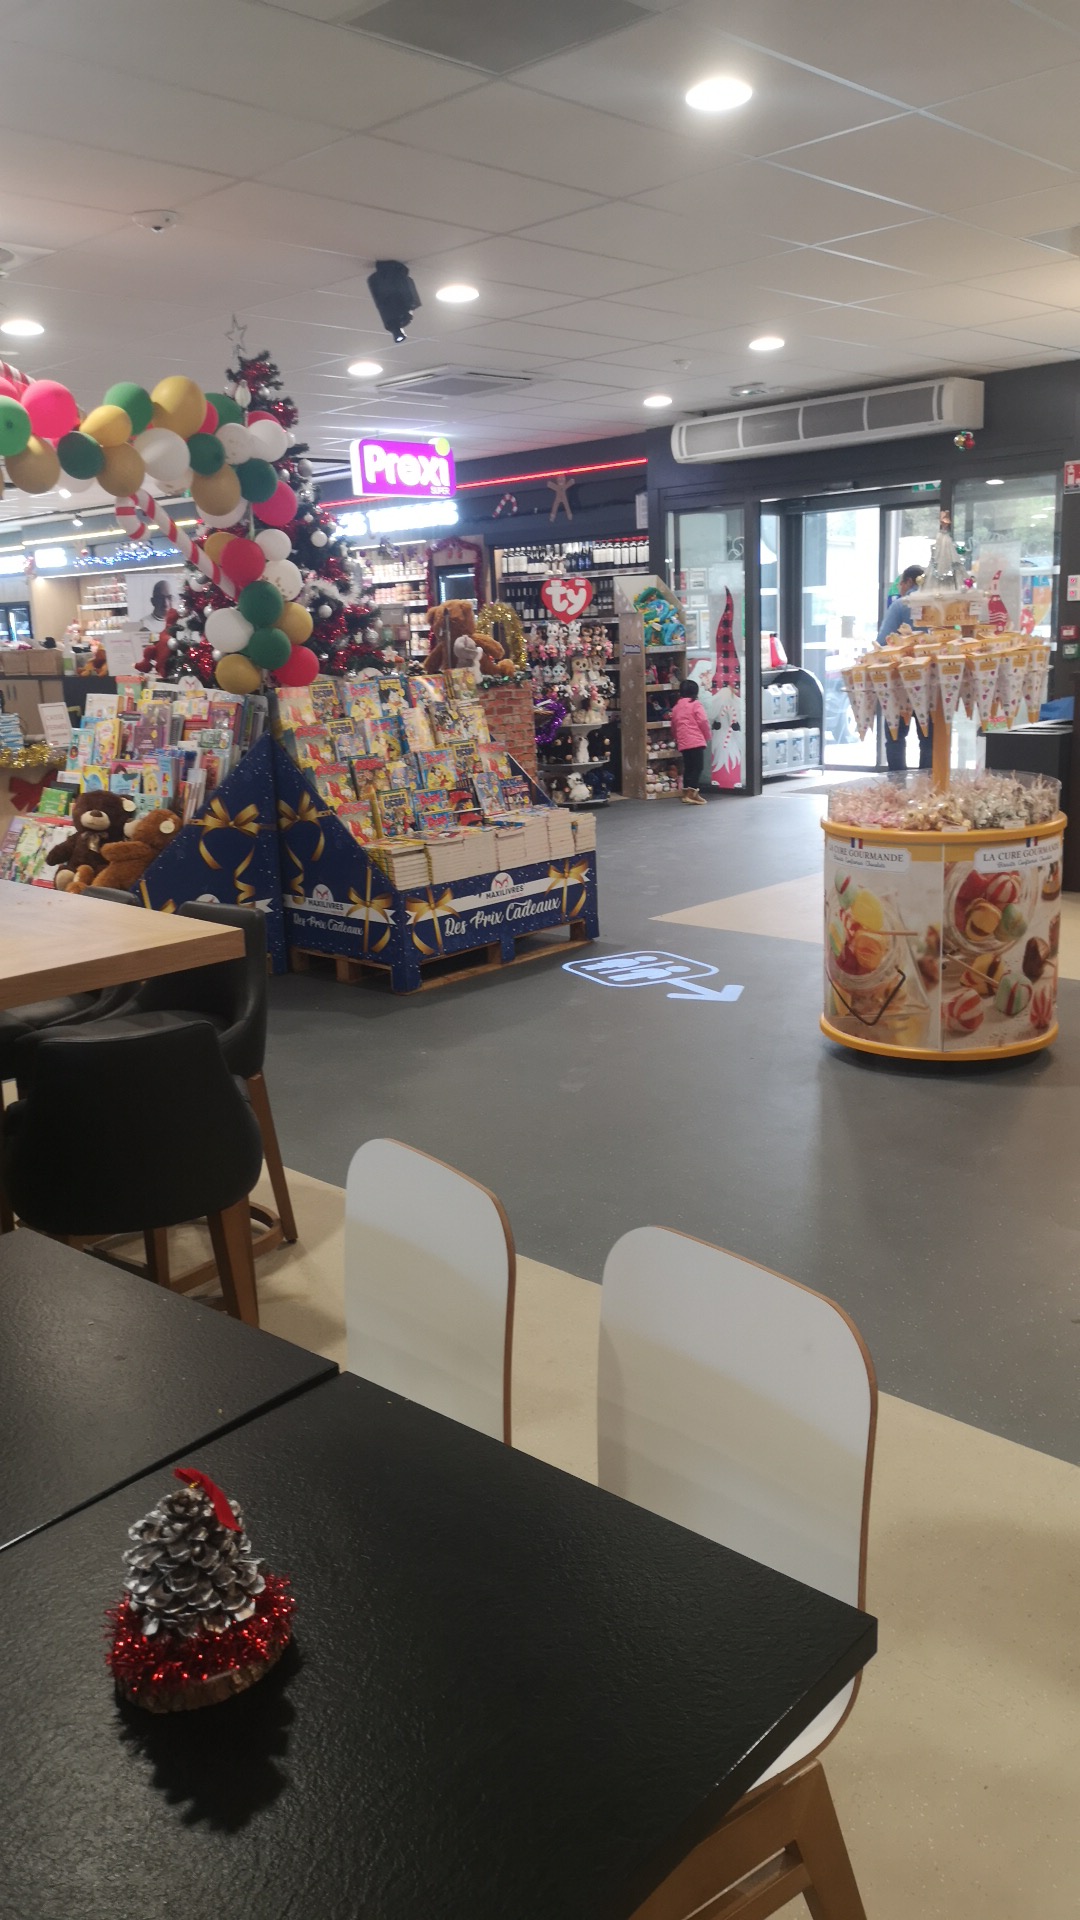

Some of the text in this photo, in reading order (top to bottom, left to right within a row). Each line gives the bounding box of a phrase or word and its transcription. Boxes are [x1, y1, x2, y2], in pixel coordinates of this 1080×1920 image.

[362, 438, 451, 487] Proxi
[430, 486, 451, 495] SUPER
[545, 584, 587, 615] ty
[848, 849, 904, 863] GOURMANDE
[983, 853, 996, 862] LA
[997, 850, 1022, 861] CURE
[486, 884, 525, 899] MAXILIVRES
[444, 897, 562, 937] Des Prix Cadeaux
